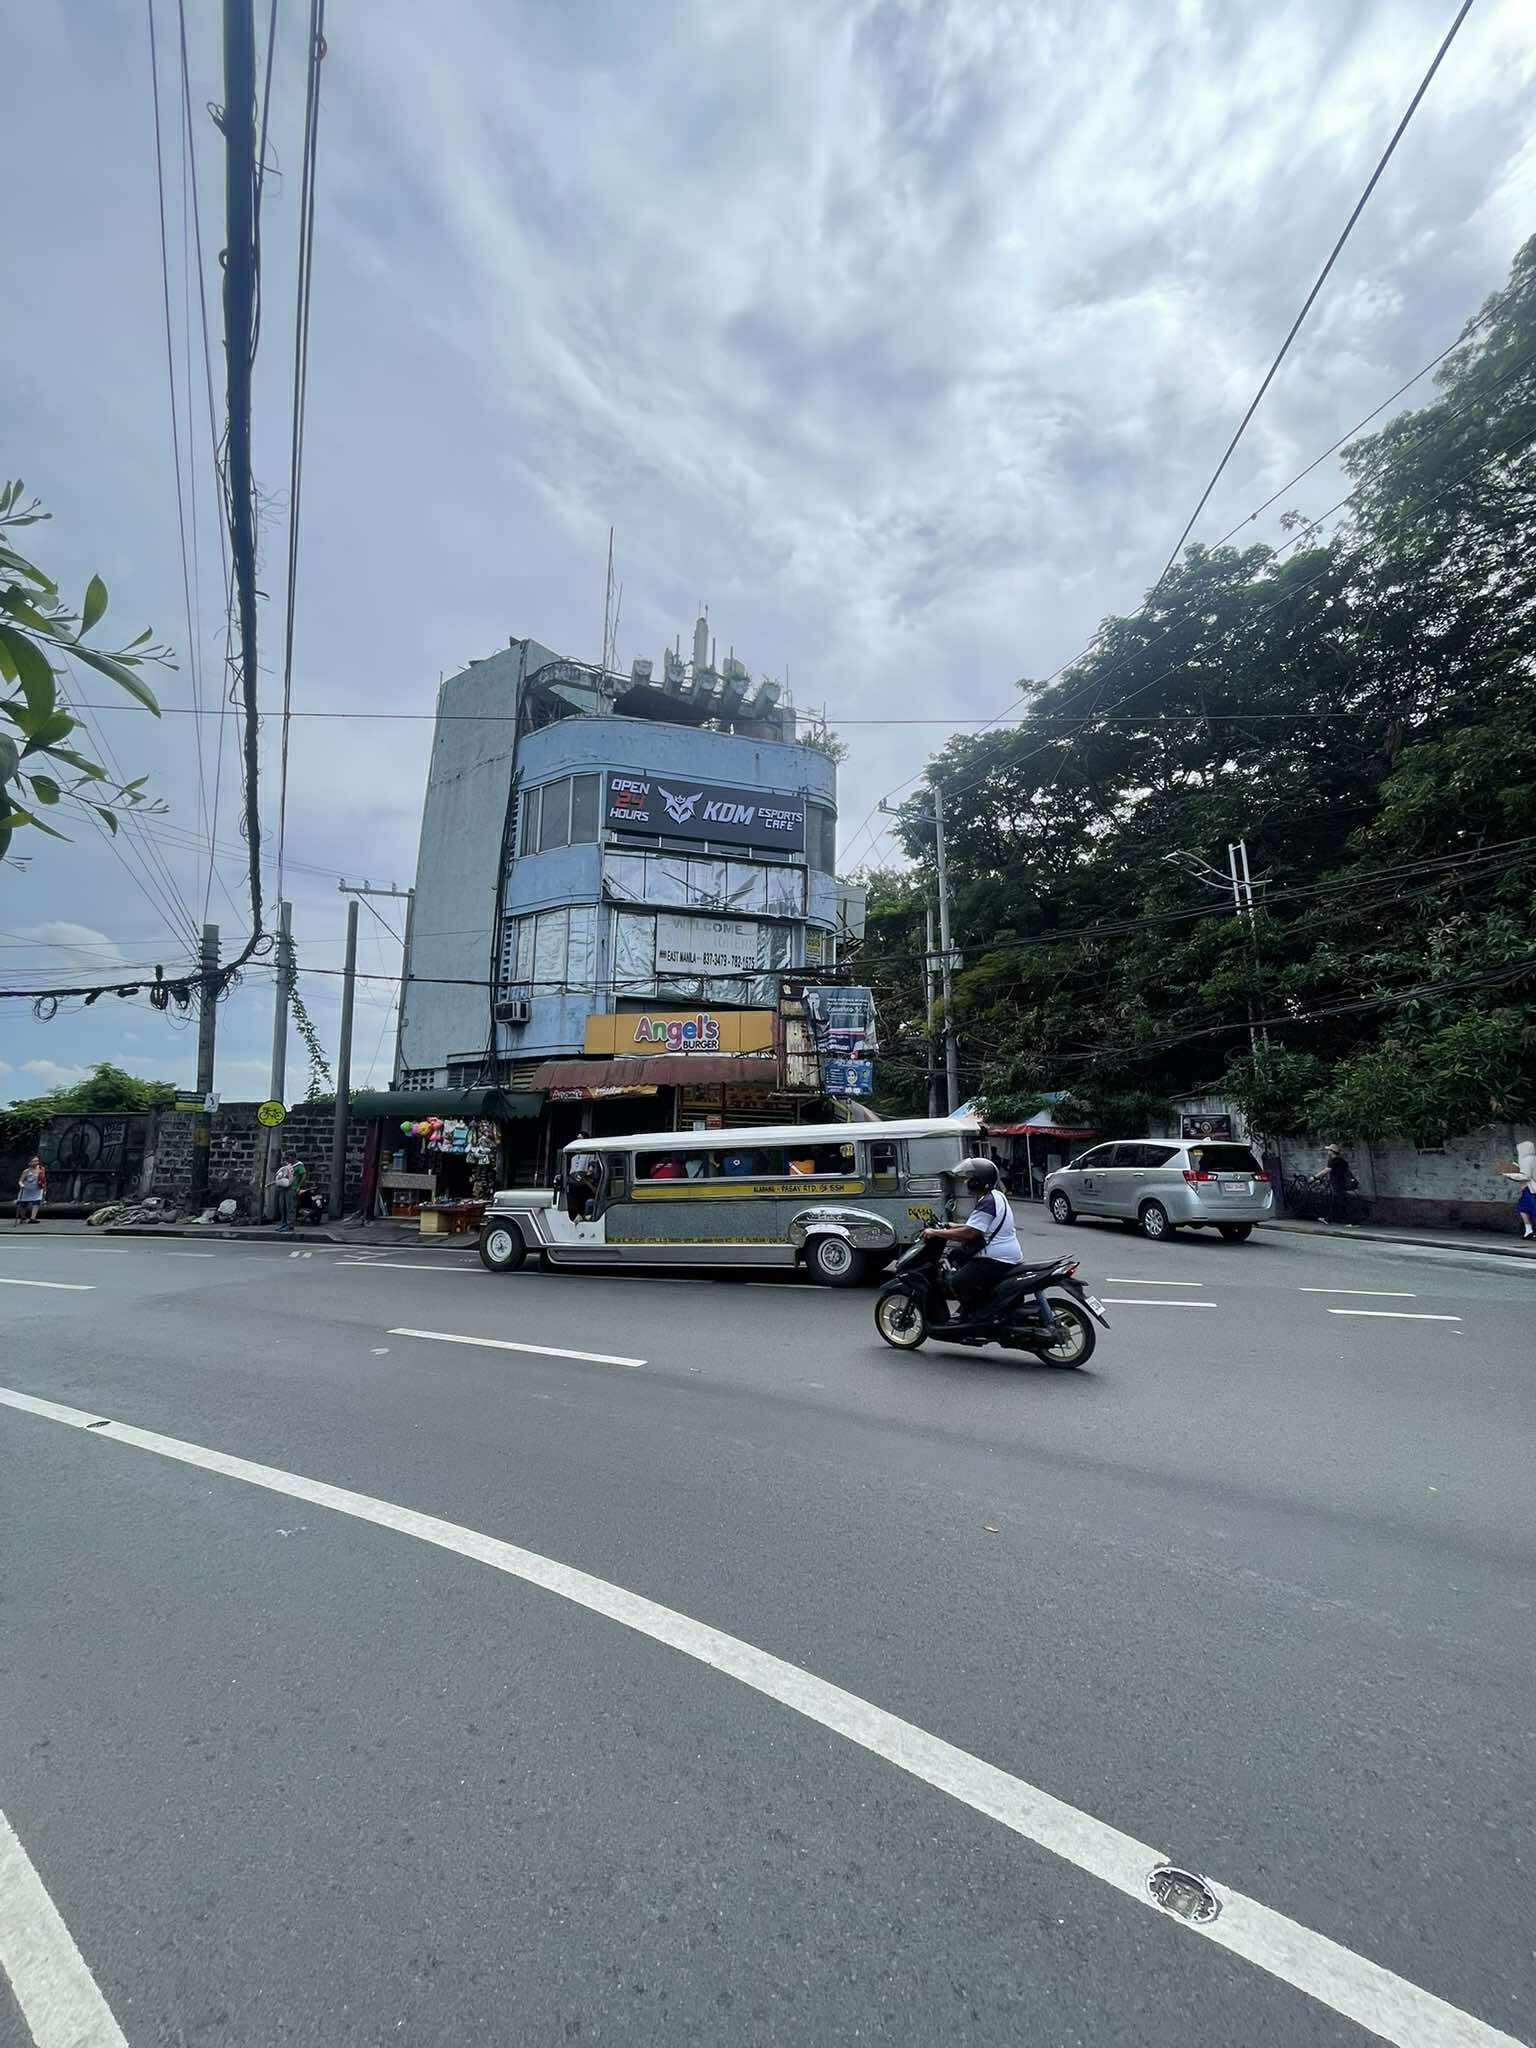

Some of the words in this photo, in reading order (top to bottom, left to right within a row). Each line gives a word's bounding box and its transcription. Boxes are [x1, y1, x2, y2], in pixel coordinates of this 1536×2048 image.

[611, 779, 650, 794] OPEN
[616, 792, 645, 808] 24
[609, 807, 650, 822] HOURS
[702, 800, 755, 825] KDM
[758, 807, 803, 822] ESPORTS
[765, 819, 794, 831] CAFE
[634, 1013, 719, 1050] Angel's
[682, 1040, 719, 1050] BURGER
